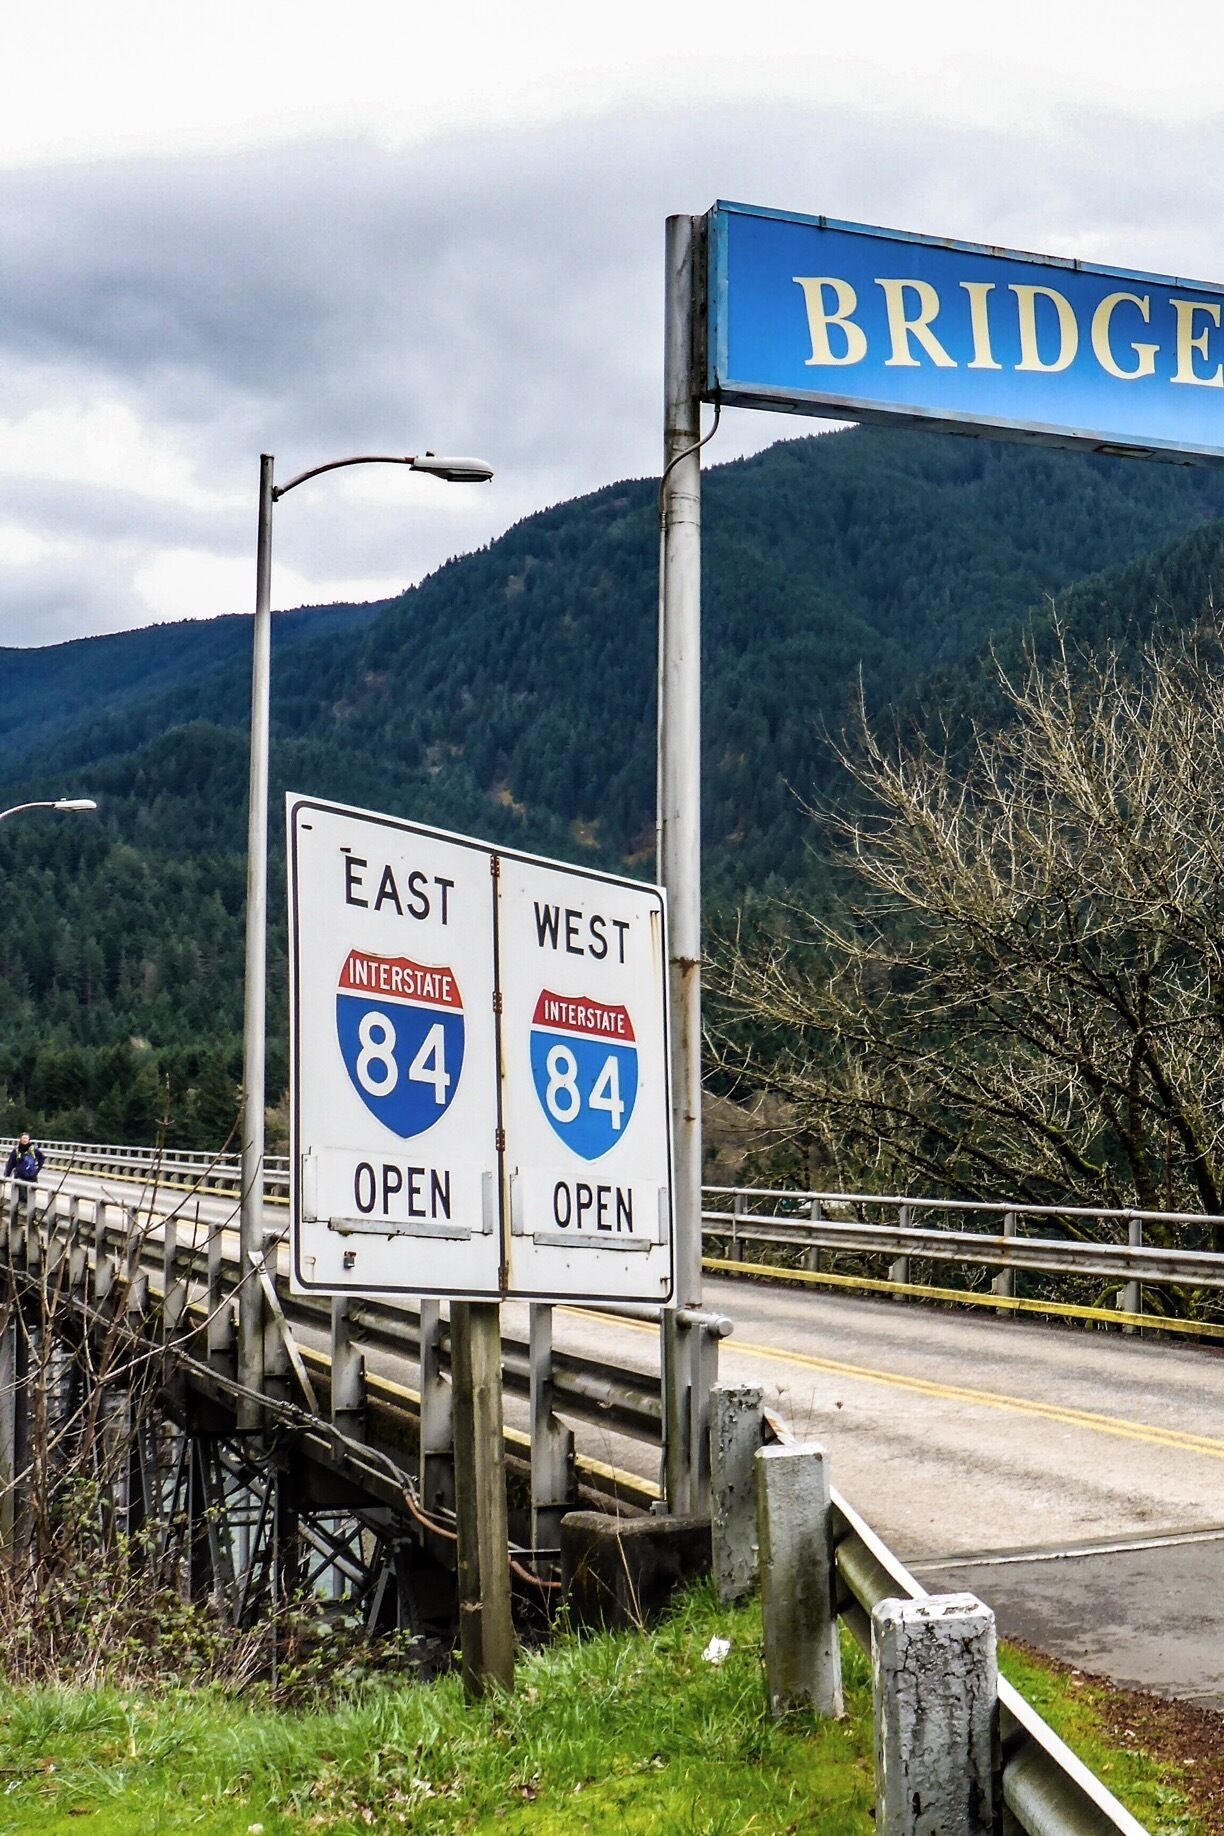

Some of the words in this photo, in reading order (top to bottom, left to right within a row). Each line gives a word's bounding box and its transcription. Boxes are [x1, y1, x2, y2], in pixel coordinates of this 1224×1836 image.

[792, 277, 1224, 388] BRIDGE
[345, 854, 455, 926] EAST
[533, 901, 630, 964] WEST
[349, 956, 453, 1002] INTERSTATE
[544, 1001, 626, 1034] INTERSTATE
[356, 1010, 451, 1105] 84
[546, 1044, 625, 1131] 84
[354, 1161, 451, 1220] OPEN
[553, 1180, 634, 1233] OPEN
